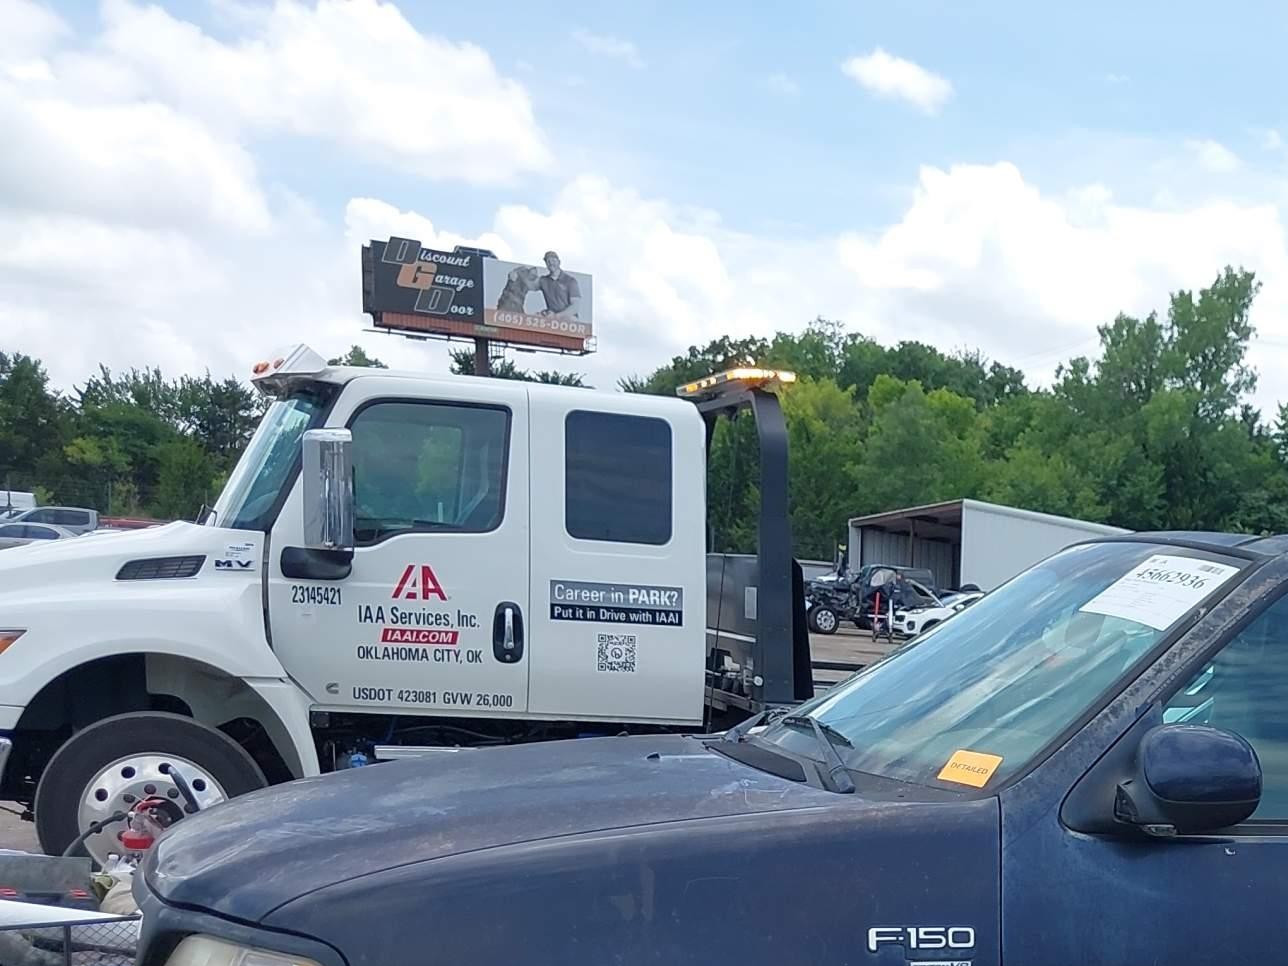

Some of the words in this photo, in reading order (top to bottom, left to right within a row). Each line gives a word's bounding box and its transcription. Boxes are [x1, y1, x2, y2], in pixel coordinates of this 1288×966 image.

[396, 262, 475, 292] Garage
[414, 286, 474, 315] Door
[1136, 568, 1209, 589] 45662936
[292, 585, 342, 605] 23145421
[554, 584, 606, 602] Career
[611, 587, 624, 604] in
[629, 588, 679, 607] PARK?
[358, 605, 385, 624] IAA
[390, 606, 454, 628] Services,
[457, 609, 481, 628] Inc.
[554, 605, 573, 619] Put
[575, 607, 584, 619] it
[586, 608, 596, 620] in
[600, 608, 627, 621] Drive
[630, 610, 653, 623] with
[656, 612, 679, 624] IAAI
[386, 630, 453, 643] IAAI.COM
[357, 645, 429, 662] OKLAHOMA
[433, 648, 463, 664] CITY,
[466, 650, 483, 663] OK
[352, 687, 393, 701] USDOT
[397, 690, 437, 703] 423081
[443, 691, 473, 705] GVW
[476, 694, 513, 707] 26,000
[950, 761, 989, 775] DETAILED
[868, 927, 975, 951] F-150
